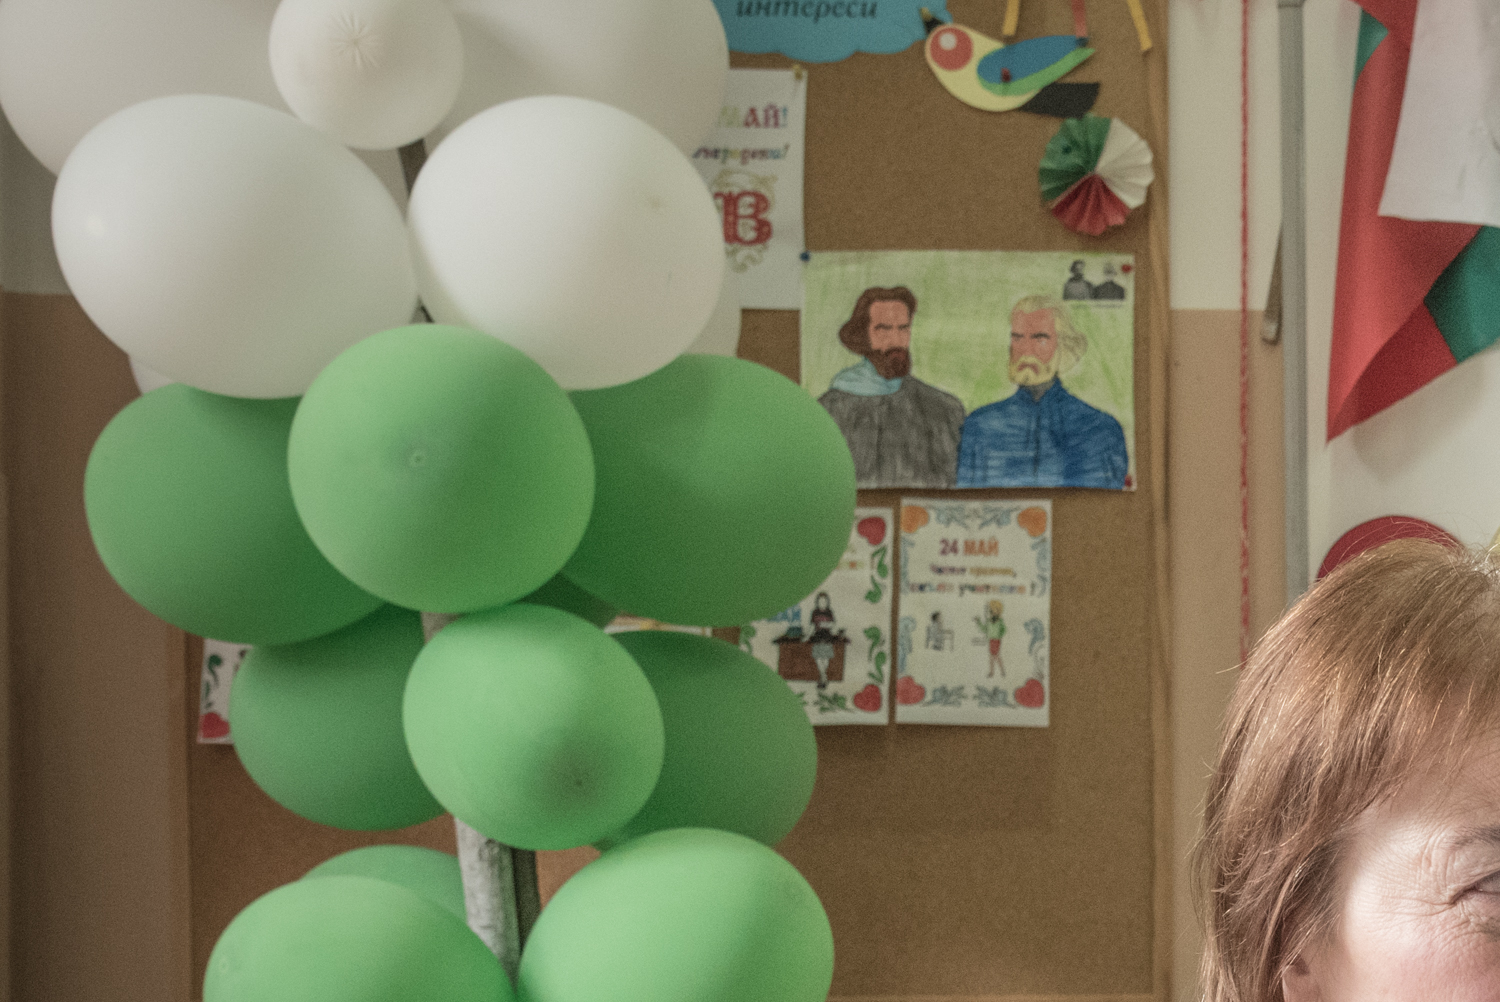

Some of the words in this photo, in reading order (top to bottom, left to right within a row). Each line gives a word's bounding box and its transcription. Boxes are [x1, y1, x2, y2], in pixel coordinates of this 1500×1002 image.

[736, 0, 878, 22] интереси
[939, 537, 959, 556] 24
[963, 535, 1000, 556] МАЙ
